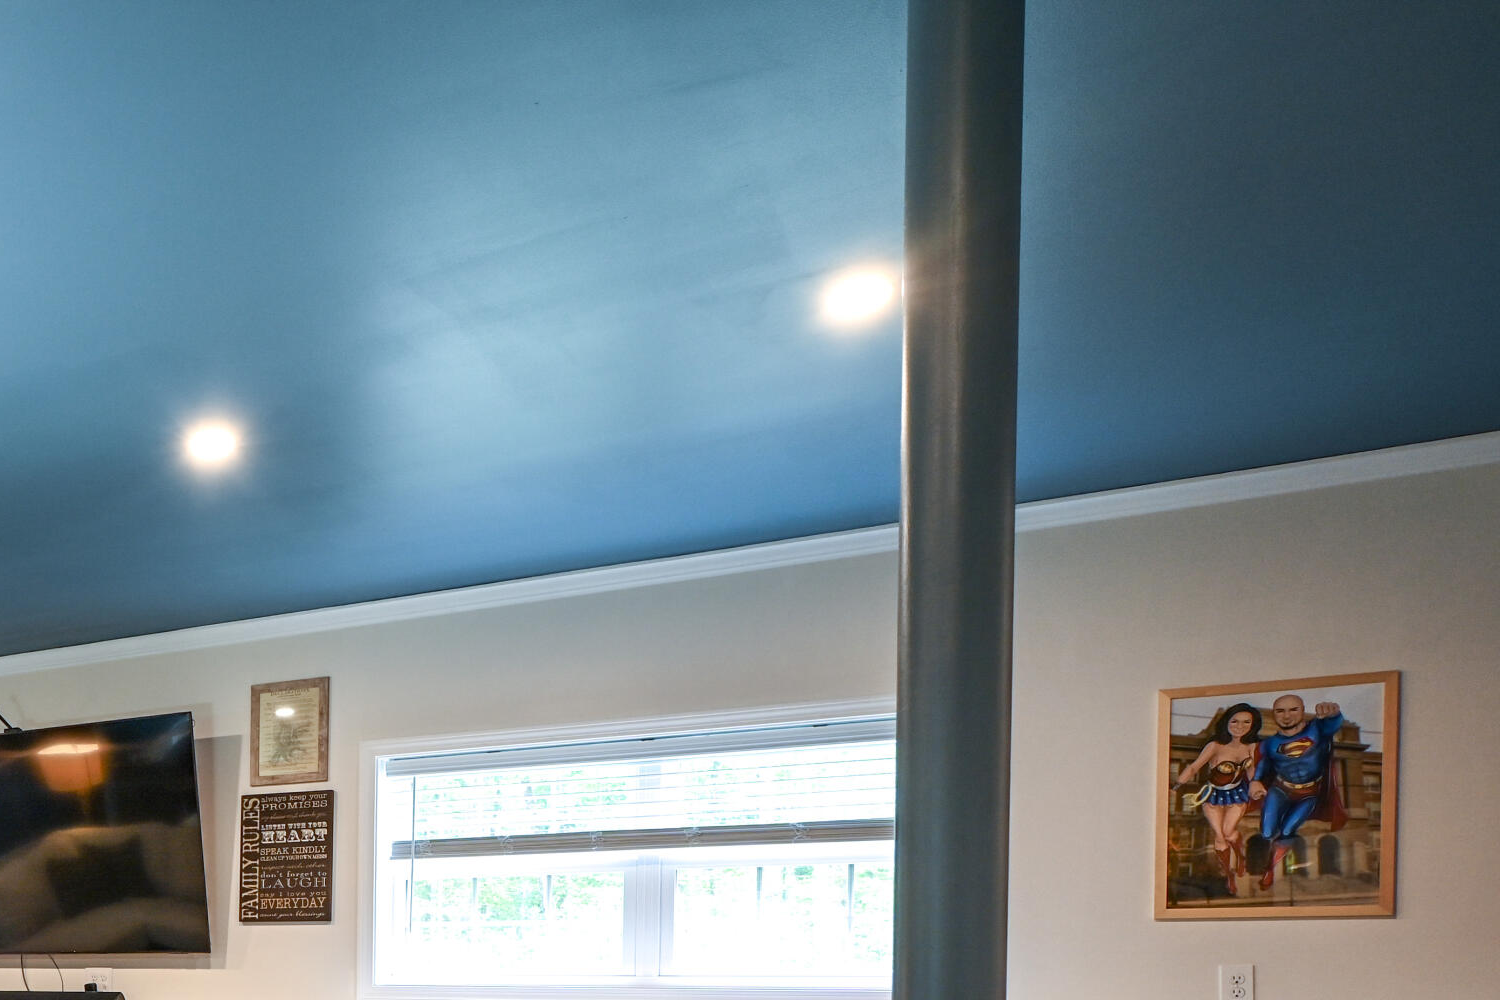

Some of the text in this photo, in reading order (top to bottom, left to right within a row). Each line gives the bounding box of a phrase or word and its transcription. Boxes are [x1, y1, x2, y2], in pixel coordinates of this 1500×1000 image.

[261, 793, 328, 804] always keep your
[261, 800, 328, 811] PROMISES
[261, 828, 328, 844] HEART
[260, 845, 327, 856] SPEAK KINDLY
[241, 797, 260, 920] FAMILY RULES
[260, 870, 283, 878] don't
[286, 870, 313, 879] forget
[261, 876, 328, 889] LAUGH
[260, 896, 328, 910] EVERYDAY
